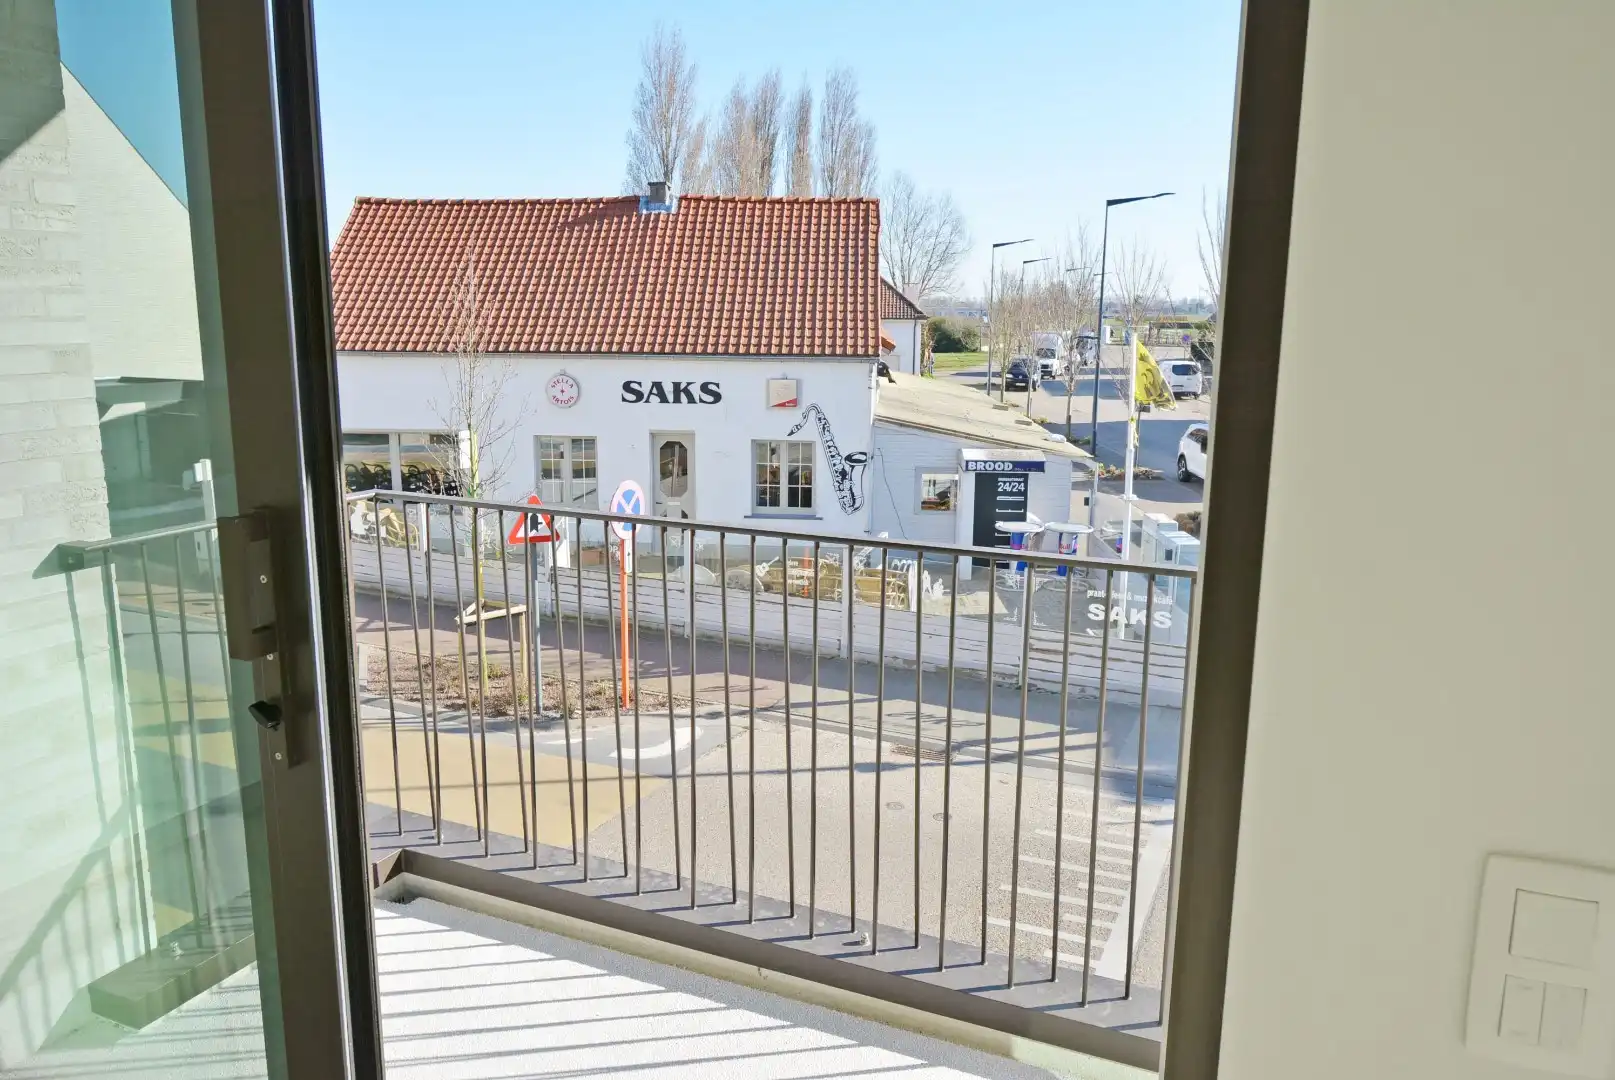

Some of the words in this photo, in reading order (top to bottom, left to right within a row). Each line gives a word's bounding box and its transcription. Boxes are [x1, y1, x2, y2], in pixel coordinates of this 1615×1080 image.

[551, 378, 574, 389] STELLA
[621, 380, 723, 405] SAKS
[551, 395, 575, 405] ARTOIS
[967, 461, 1013, 471] BROOD
[997, 482, 1025, 492] 24/24
[1087, 603, 1172, 629] SAKS
